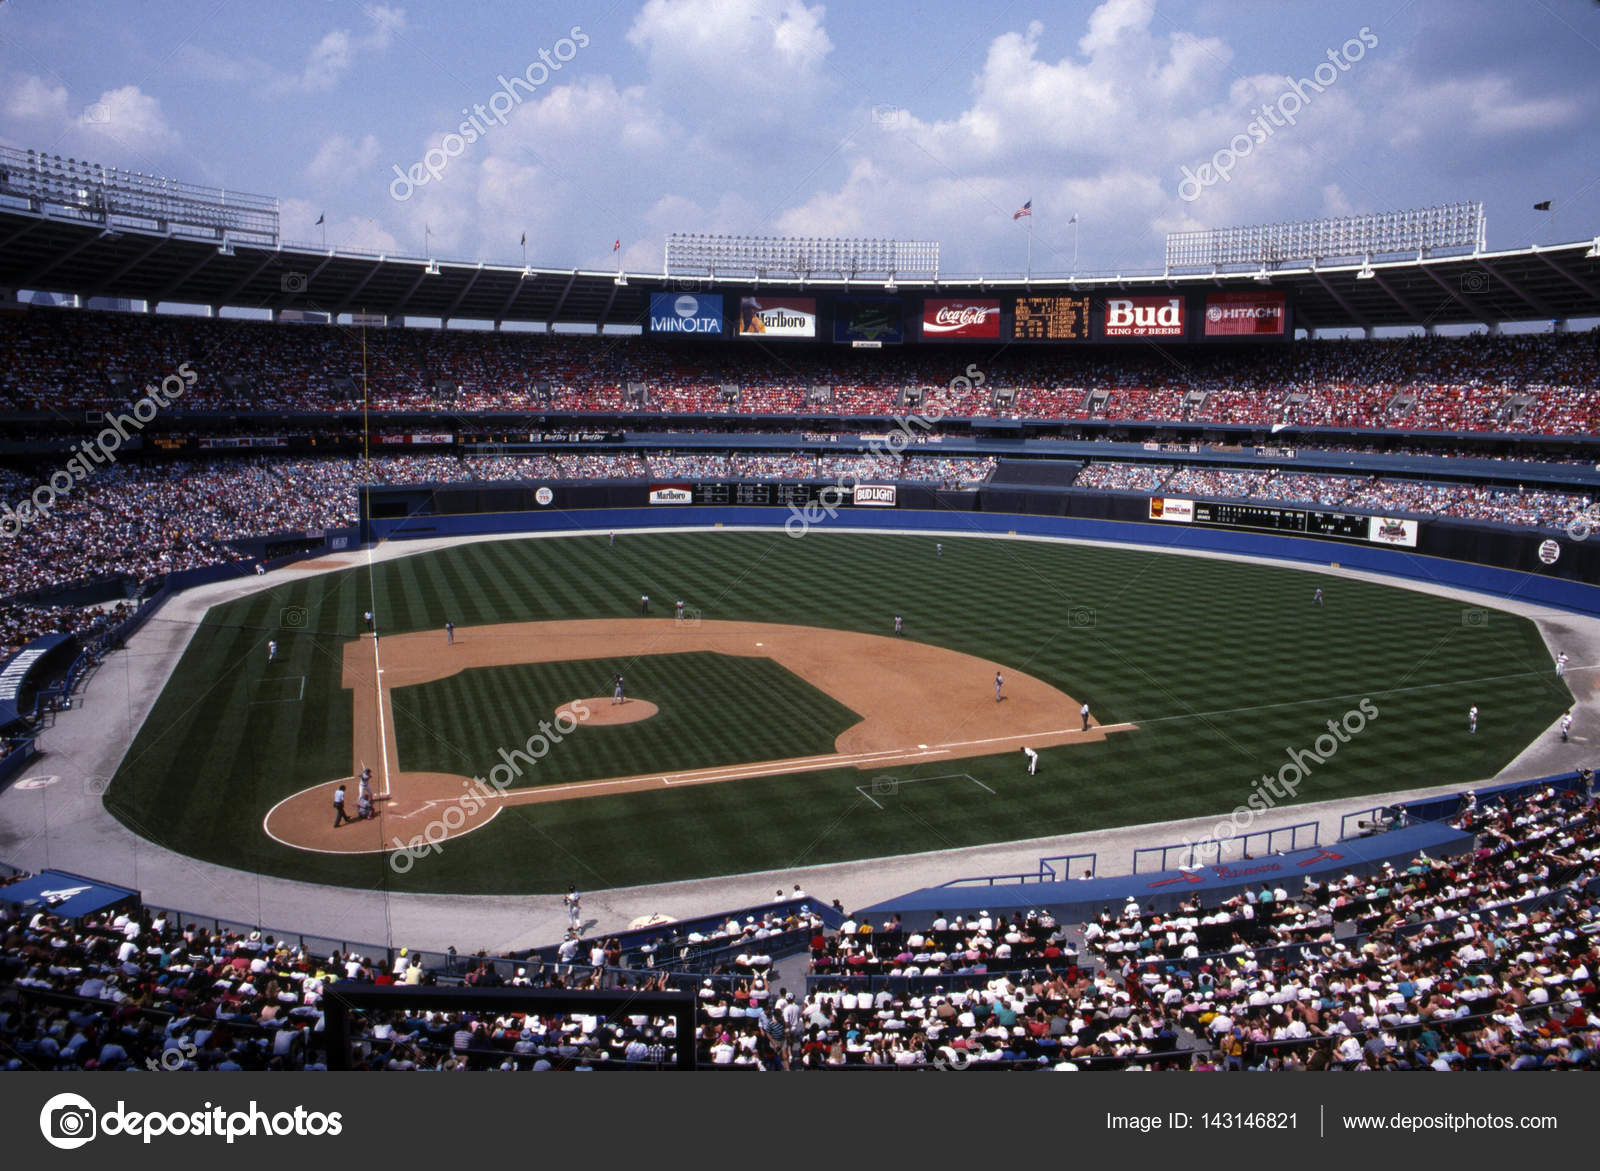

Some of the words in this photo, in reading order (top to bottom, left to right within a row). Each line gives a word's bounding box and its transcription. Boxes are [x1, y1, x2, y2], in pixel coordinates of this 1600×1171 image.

[936, 306, 986, 325] Coca-Cola
[1107, 299, 1181, 327] Bud
[1223, 307, 1281, 319] HITACHI
[651, 317, 721, 332] MINOLTA
[756, 312, 806, 329] Marlboro
[1107, 327, 1132, 335] KING
[1133, 327, 1147, 335] OF
[1148, 327, 1181, 335] BEERS
[656, 490, 686, 500] Marlboro
[857, 488, 873, 501] BUD
[872, 488, 893, 501] LIGHT
